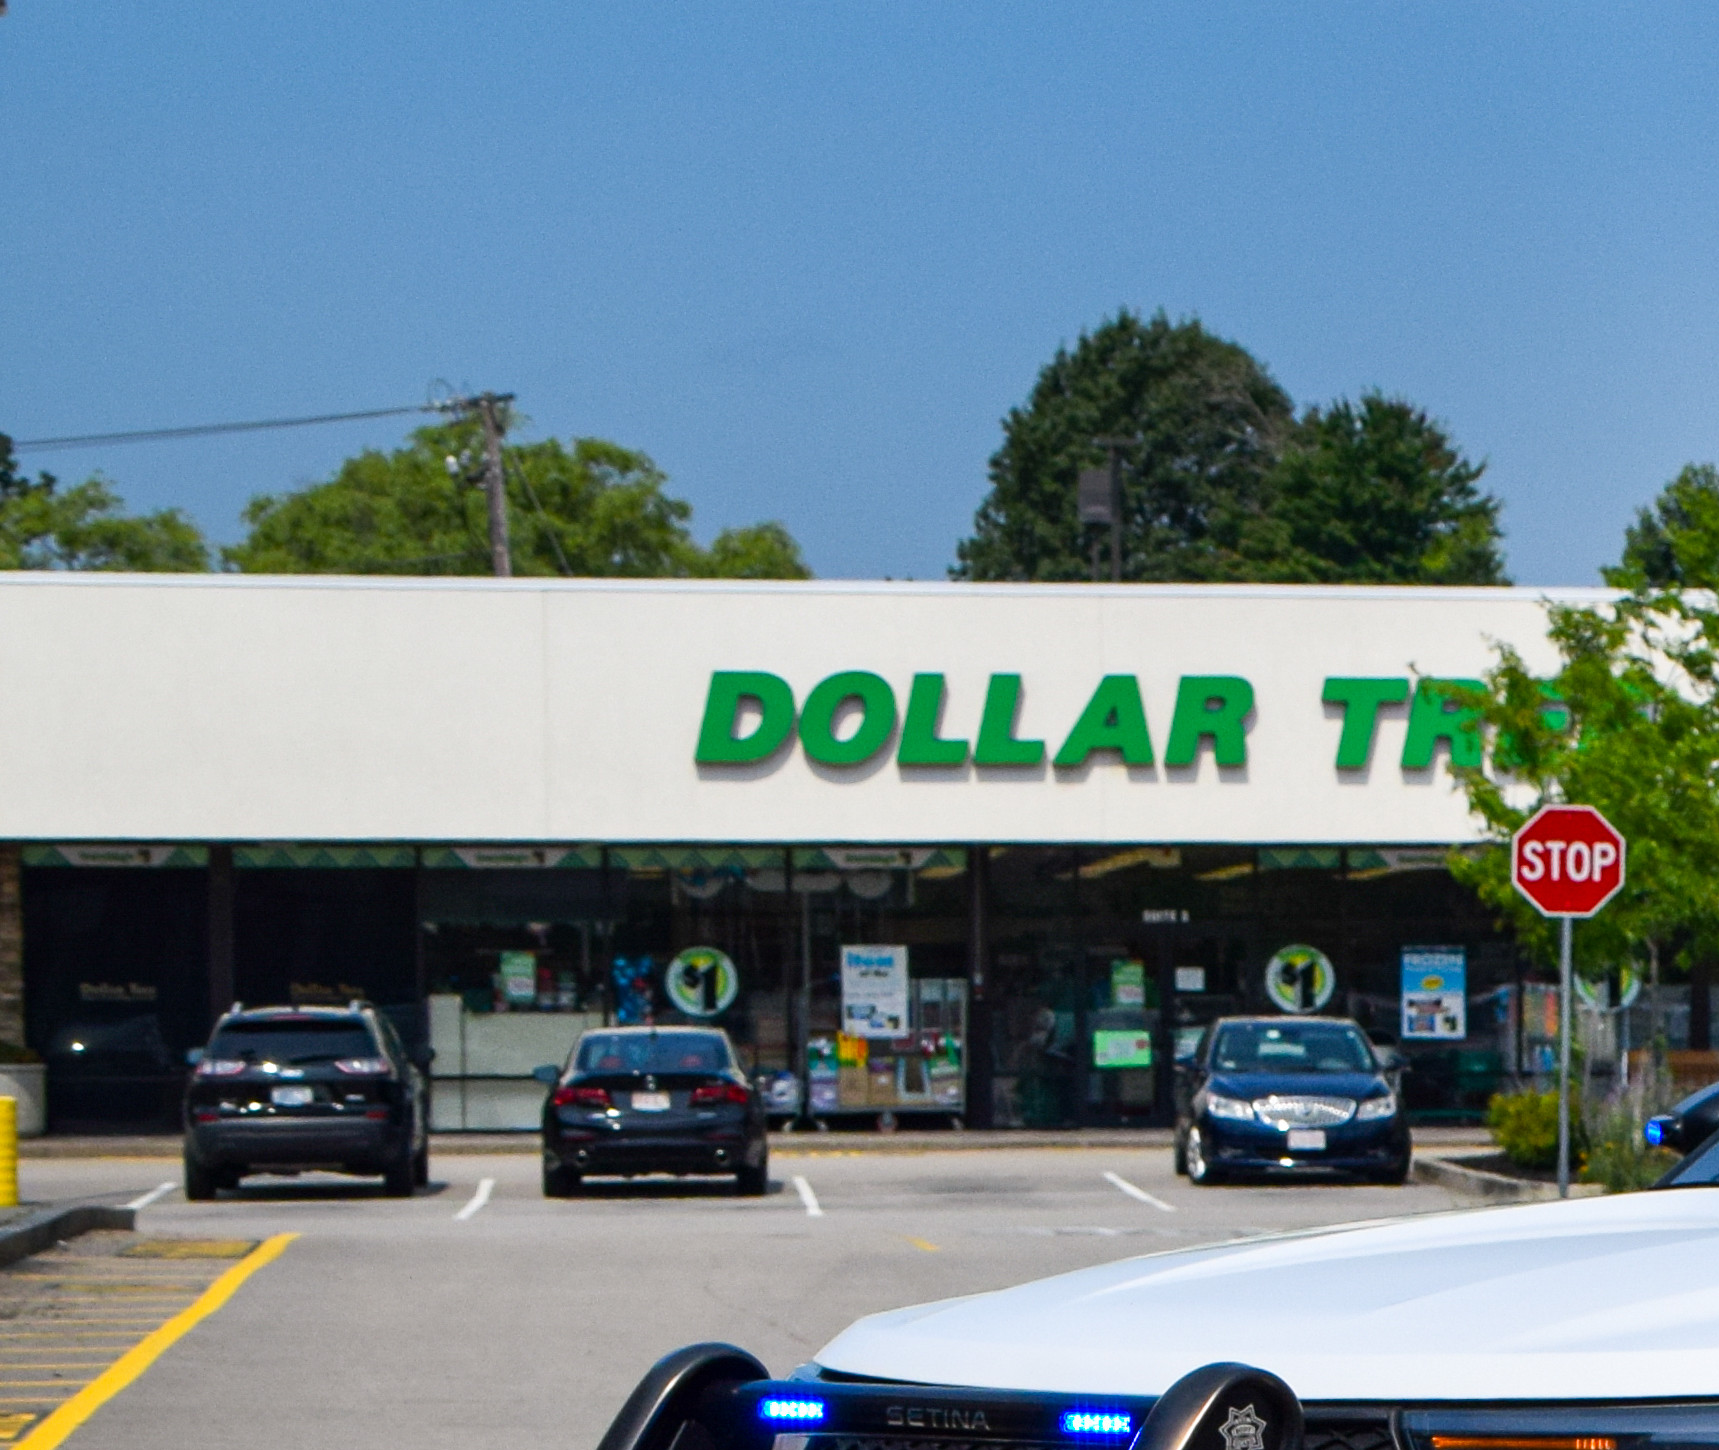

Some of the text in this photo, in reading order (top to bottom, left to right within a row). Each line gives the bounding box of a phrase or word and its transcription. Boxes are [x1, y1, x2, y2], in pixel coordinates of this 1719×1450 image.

[694, 669, 1255, 768] DOLLAR
[1520, 840, 1617, 883] STOP
[886, 1405, 991, 1431] SETINA
